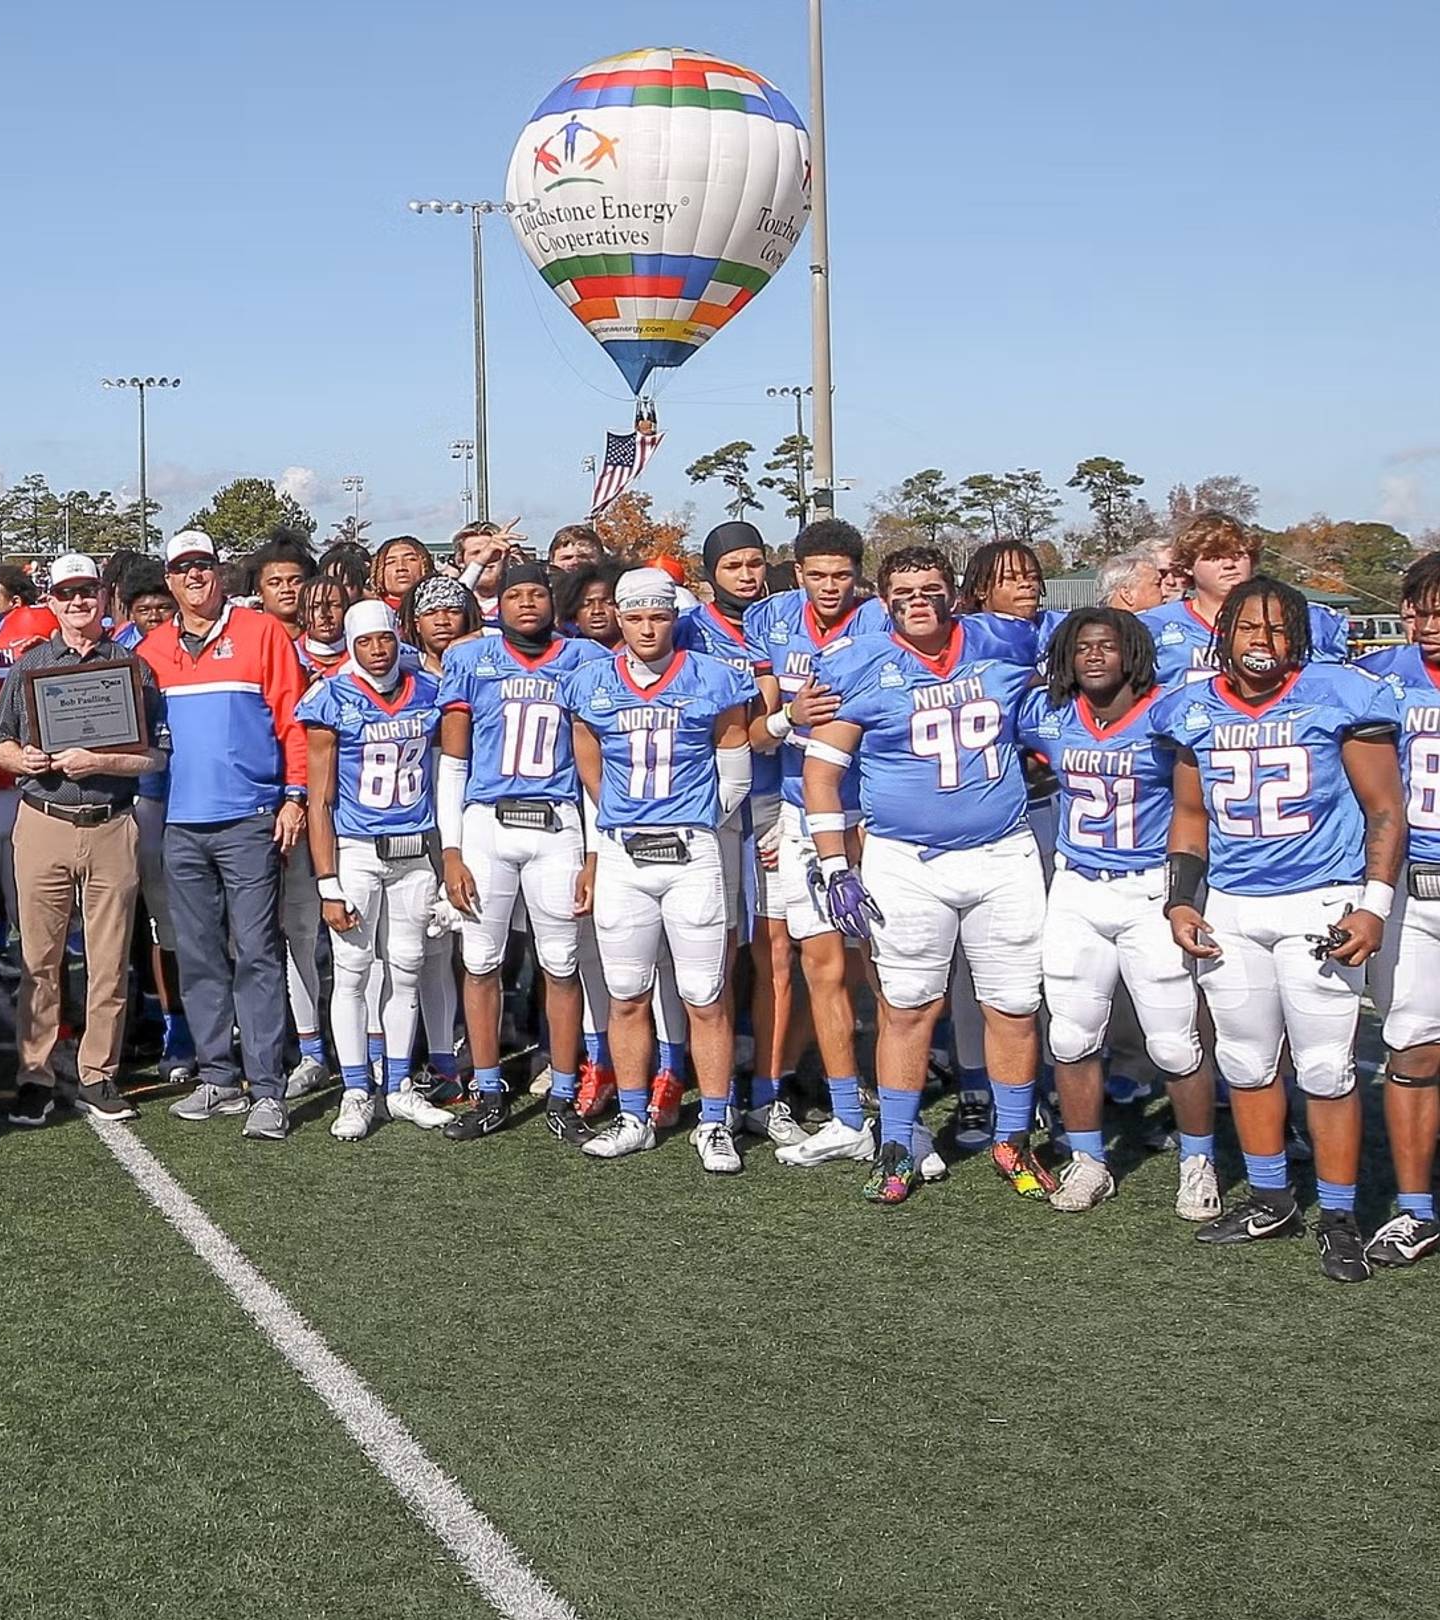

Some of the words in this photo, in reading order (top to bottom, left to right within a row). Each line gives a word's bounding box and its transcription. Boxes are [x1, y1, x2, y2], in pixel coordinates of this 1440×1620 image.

[600, 196, 678, 223] Energy
[536, 225, 649, 253] Cooperatives
[60, 698, 76, 707] Bob
[501, 678, 558, 701] NORTH
[913, 676, 983, 711] NORTH
[365, 719, 422, 742] NORTH
[617, 707, 679, 732] NORTH
[501, 702, 561, 777] 10
[910, 699, 1001, 789] 99
[1214, 721, 1293, 749] NORTH
[359, 736, 427, 809] 88
[628, 729, 672, 800] 11
[1062, 749, 1134, 776] NORTH
[1211, 746, 1311, 838] 22
[1067, 772, 1137, 849] 21
